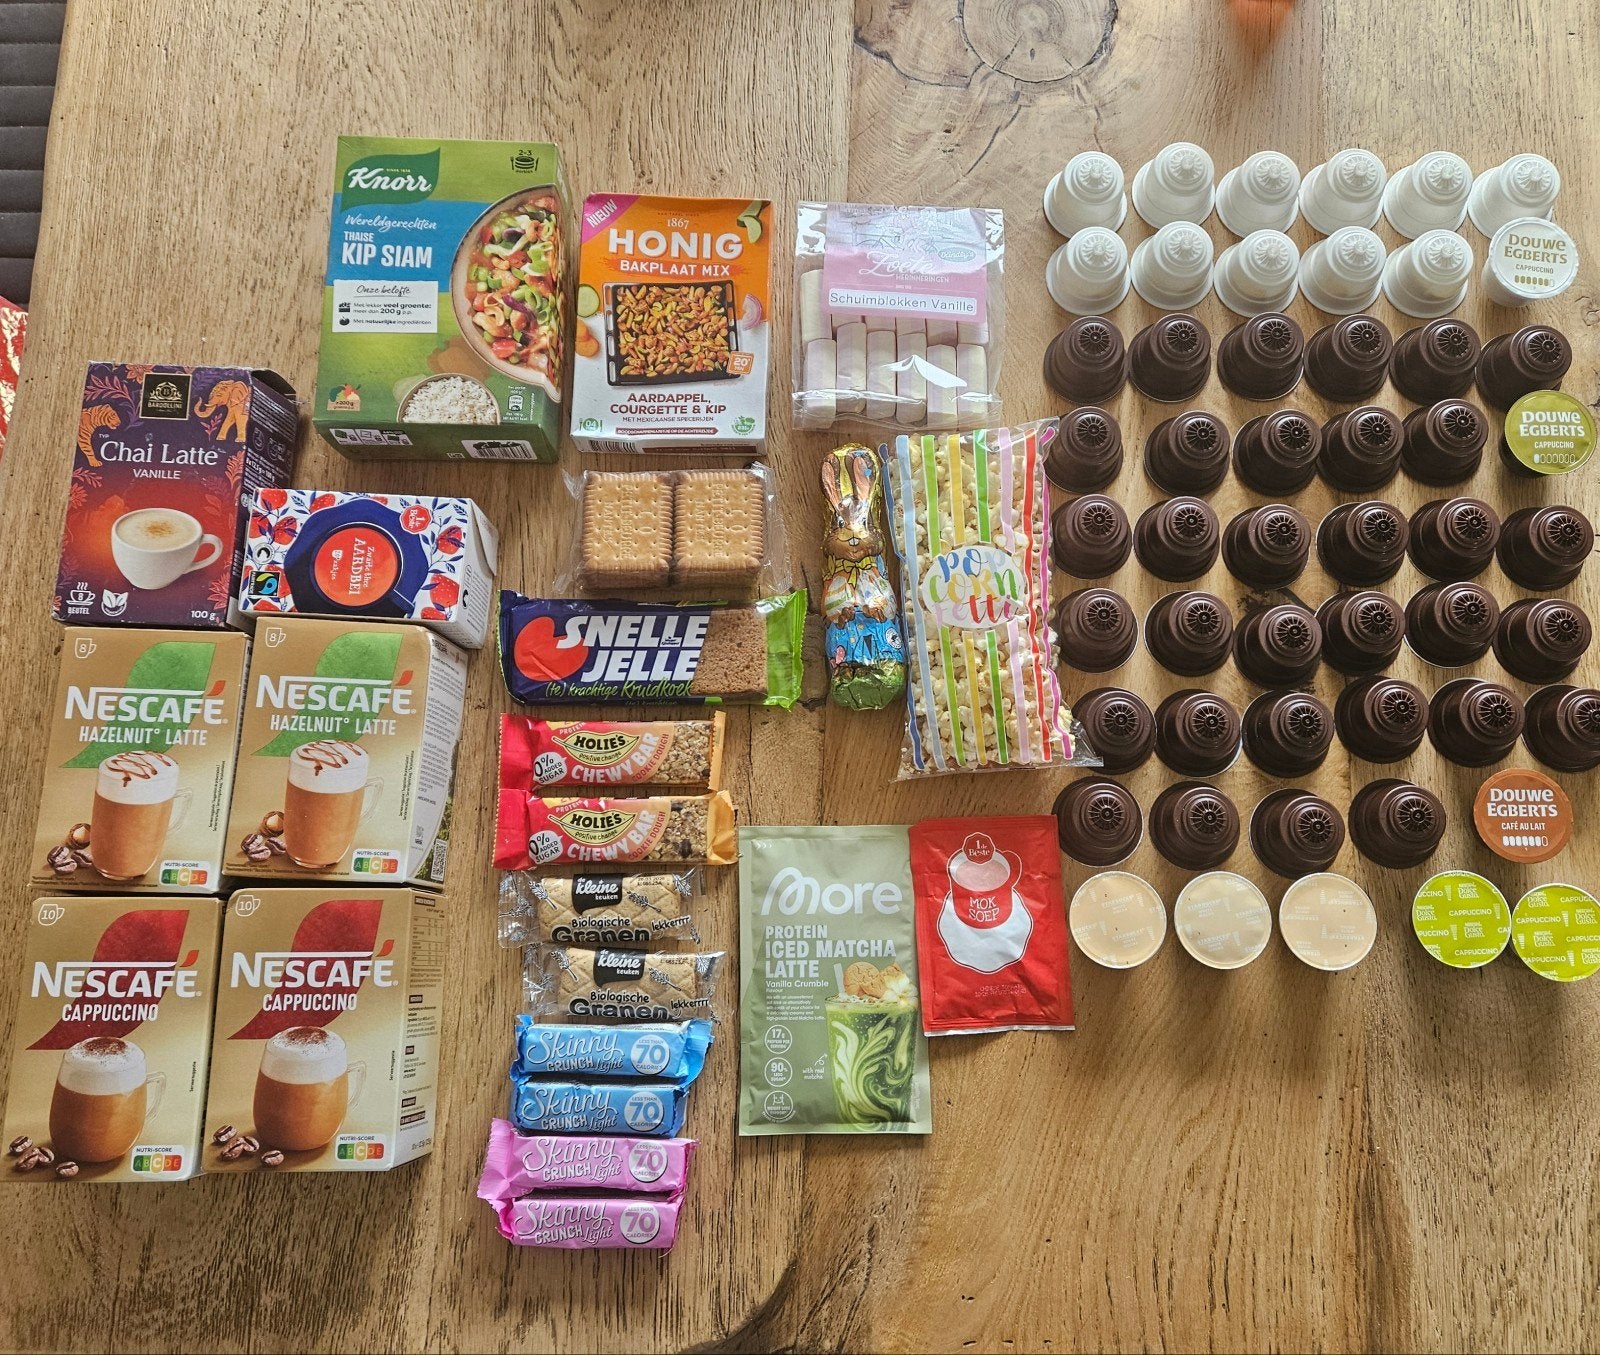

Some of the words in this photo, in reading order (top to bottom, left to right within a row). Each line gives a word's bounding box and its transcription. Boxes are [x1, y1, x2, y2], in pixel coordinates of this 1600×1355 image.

[348, 167, 431, 192] Knorr
[586, 199, 618, 228] NIEUW
[345, 213, 437, 232] Wereldgerechten
[667, 218, 689, 230] 1867
[344, 231, 375, 242] THAISE
[608, 227, 743, 260] HONIG
[341, 242, 377, 265] KIP
[380, 245, 433, 268] SIAM
[858, 250, 934, 277] Zoete
[1504, 246, 1568, 264] EGBERTS
[619, 259, 697, 276] BAKPLAAT
[702, 264, 730, 277] MIX
[1515, 264, 1554, 274] CAPPUCCINO
[895, 274, 949, 283] HERINNERINGEN
[356, 285, 380, 294] Onze
[381, 286, 411, 297] belofte
[829, 292, 927, 309] Schuimblokken
[930, 299, 974, 312] Vanille
[627, 393, 711, 404] AARDAPPEL,
[610, 404, 687, 415] COURGETTE
[692, 405, 701, 414] &
[705, 405, 727, 414] KIP
[1519, 424, 1585, 437] EGBERTS
[99, 440, 153, 463] Chai
[160, 443, 219, 466] Latte
[1534, 441, 1574, 449] CAPPUCCINO
[133, 468, 181, 480] VANILLE
[348, 537, 367, 595] AARDBEI
[365, 546, 375, 571] Zwarte
[938, 549, 1005, 583] pop
[363, 572, 372, 588] thee
[77, 592, 84, 601] 8
[67, 607, 89, 615] BEUTEL
[191, 610, 208, 619] 100
[209, 612, 216, 621] g
[269, 633, 276, 642] 8
[555, 615, 710, 650] SNELLE
[79, 644, 87, 653] 8
[581, 649, 701, 683] JELLE
[255, 670, 414, 715] NESCAFÉ
[545, 681, 567, 697] (te)
[568, 681, 618, 700] krachtige
[621, 678, 693, 698] Kruidkoek
[64, 680, 226, 724] NESCAFÉ
[355, 719, 397, 736] LATTE
[165, 729, 207, 746] LATTE
[573, 735, 626, 751] HOLIE'S
[571, 761, 633, 784] CHEWY
[631, 732, 659, 767] BAR
[578, 753, 601, 762] positive
[600, 751, 622, 762] change
[632, 760, 656, 782] COOKIE
[654, 734, 669, 760] DOUGH
[534, 754, 554, 777] 0%
[544, 762, 563, 774] ADDED
[538, 769, 564, 784] SUGAR
[1486, 802, 1558, 817] EGBERTS
[570, 812, 623, 829] HOLIE'S
[1501, 820, 1518, 830] CAFÉ
[1530, 822, 1546, 830] LAIT
[567, 838, 629, 862] CHEWY
[627, 810, 656, 845] BAR
[575, 831, 597, 841] positive
[597, 829, 618, 841] change
[628, 837, 652, 860] COOKIE
[650, 811, 666, 838] DOUGH
[529, 832, 550, 856] 0%
[540, 840, 558, 852] ADDED
[968, 848, 991, 857] Beste
[535, 847, 560, 863] SUGAR
[575, 879, 618, 895] kleine
[238, 900, 252, 911] 10
[969, 895, 997, 910] MOK
[41, 908, 57, 920] 10
[968, 907, 1000, 922] SOEP
[1448, 908, 1492, 917] CAPPUCCINO
[1516, 916, 1561, 924] CAPPUCCINO
[571, 917, 631, 929] Biologische
[551, 927, 651, 943] Granen
[765, 925, 828, 939] PROTEIN
[765, 940, 810, 958] ICED
[816, 939, 897, 957] MATCHA
[1454, 947, 1498, 956] CAPPUCCINO
[230, 939, 395, 988] NESCAFÉ
[598, 952, 641, 969] kleine
[765, 960, 820, 978] LATTE
[31, 949, 199, 998] NESCAFÉ
[617, 968, 640, 976] keuken
[765, 980, 792, 988] Vanilla
[794, 980, 829, 988] Crumble
[262, 993, 357, 1011] CAPPUCCINO
[590, 991, 649, 1004] Biologische
[61, 1003, 159, 1022] CAPPUCCINO
[569, 998, 668, 1020] Granen
[527, 1030, 625, 1065] Skinny
[636, 1043, 663, 1064] 70
[547, 1057, 594, 1072] CRUNCH
[594, 1056, 624, 1073] Light
[521, 1088, 618, 1121] Skinny
[629, 1101, 658, 1122] 70
[541, 1116, 588, 1131] CRUNCH
[588, 1115, 617, 1131] Light
[522, 1137, 623, 1172] Skinny
[633, 1148, 663, 1169] 70
[542, 1164, 592, 1182] CRUNCH
[592, 1163, 623, 1183] Light
[514, 1201, 614, 1235] Skinny
[624, 1211, 655, 1232] 70
[534, 1226, 584, 1244] CRUNCH
[583, 1226, 613, 1245] Light
